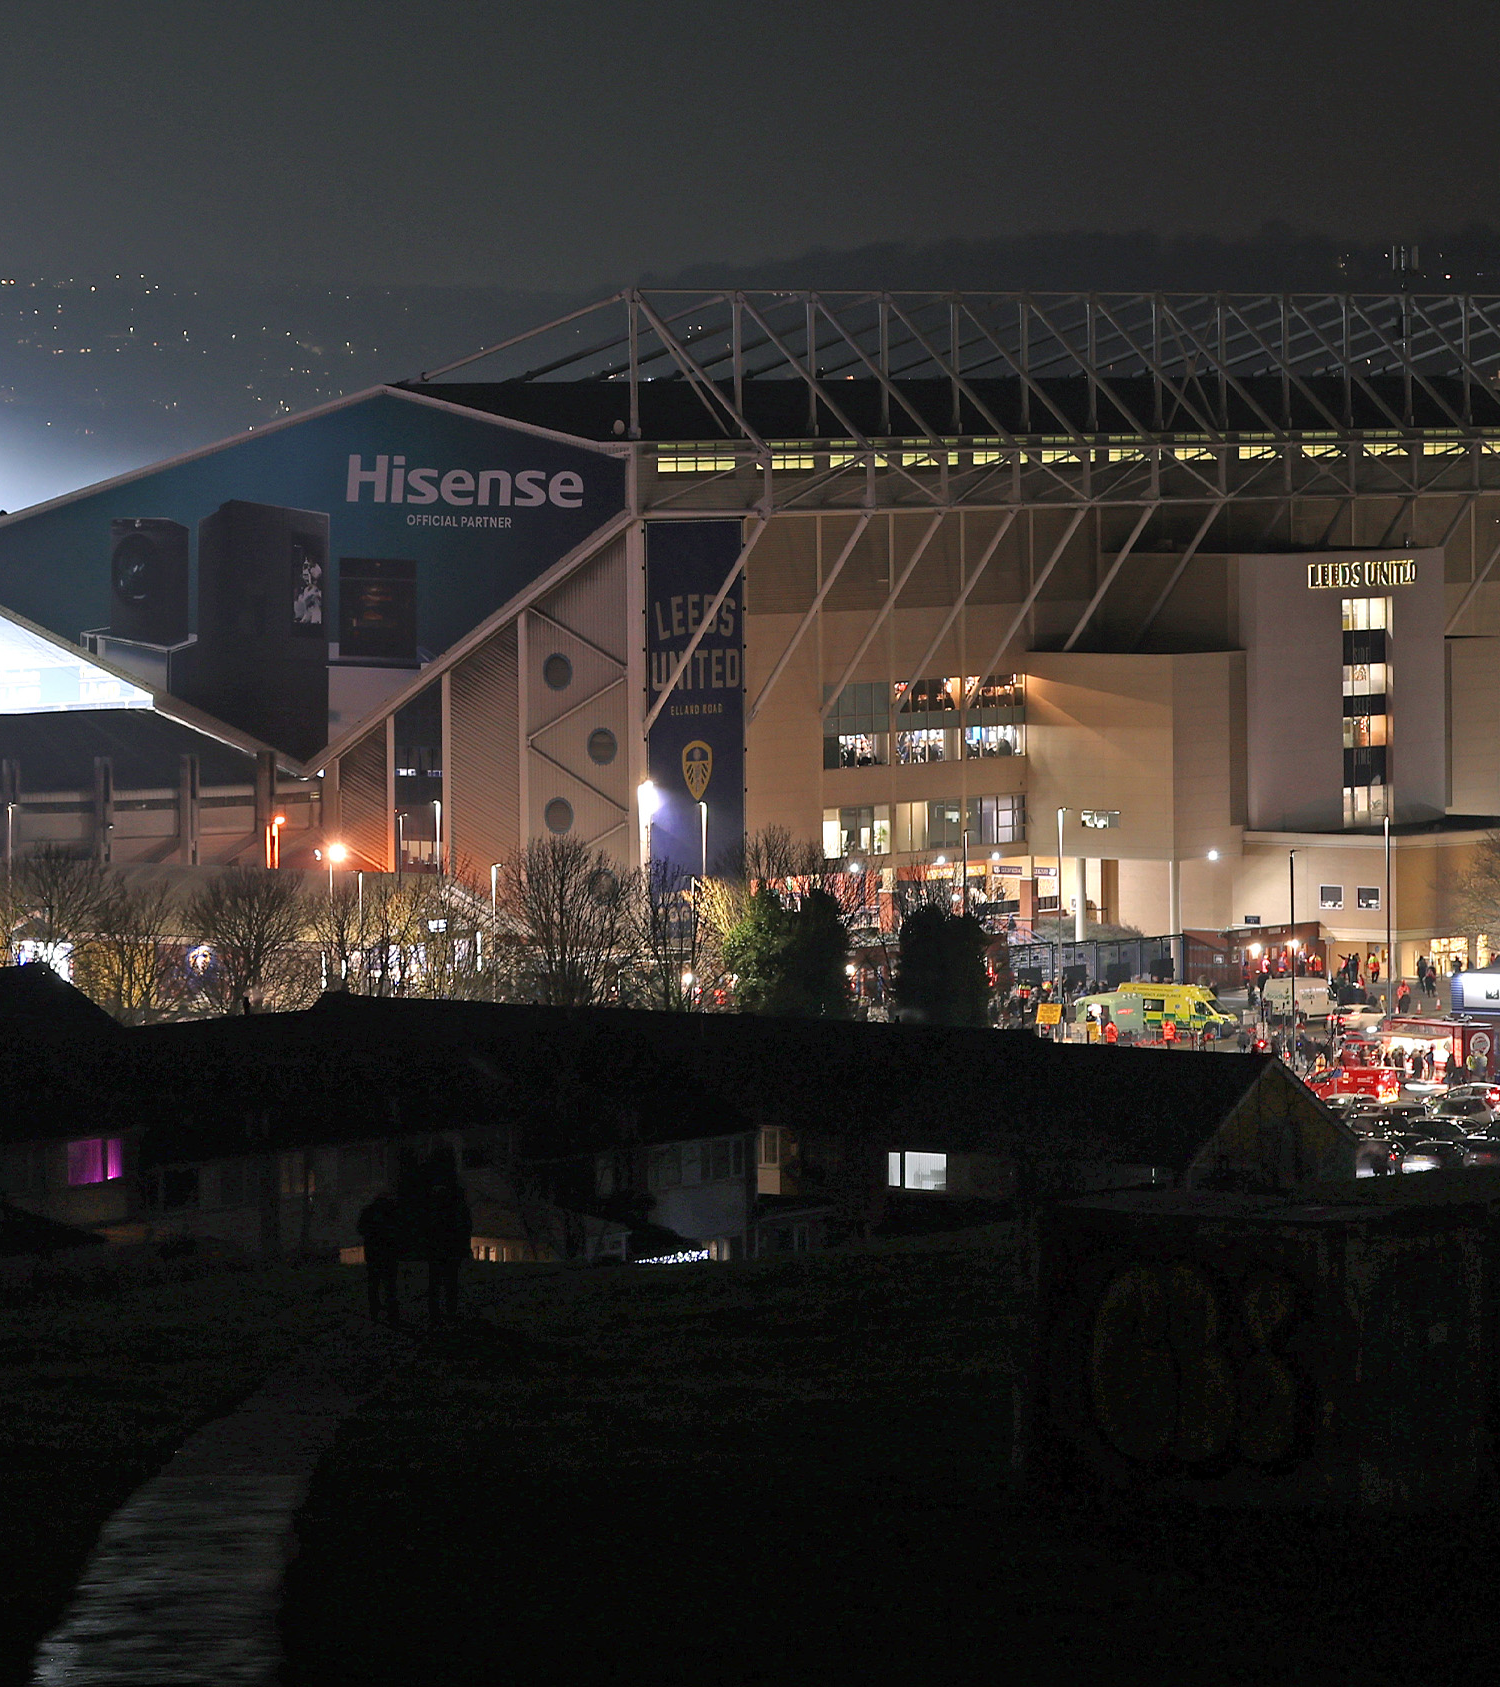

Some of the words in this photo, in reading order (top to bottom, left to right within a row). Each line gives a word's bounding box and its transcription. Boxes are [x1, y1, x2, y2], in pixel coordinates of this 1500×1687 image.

[346, 453, 584, 508] Hisense
[406, 514, 458, 527] OFFICIAL
[461, 515, 512, 529] PARTNER
[1307, 561, 1361, 589] LEEDS
[655, 594, 736, 641] LEEDS
[651, 648, 740, 692] UNITED
[670, 704, 700, 716] ELLAND
[703, 703, 723, 715] ROAD
